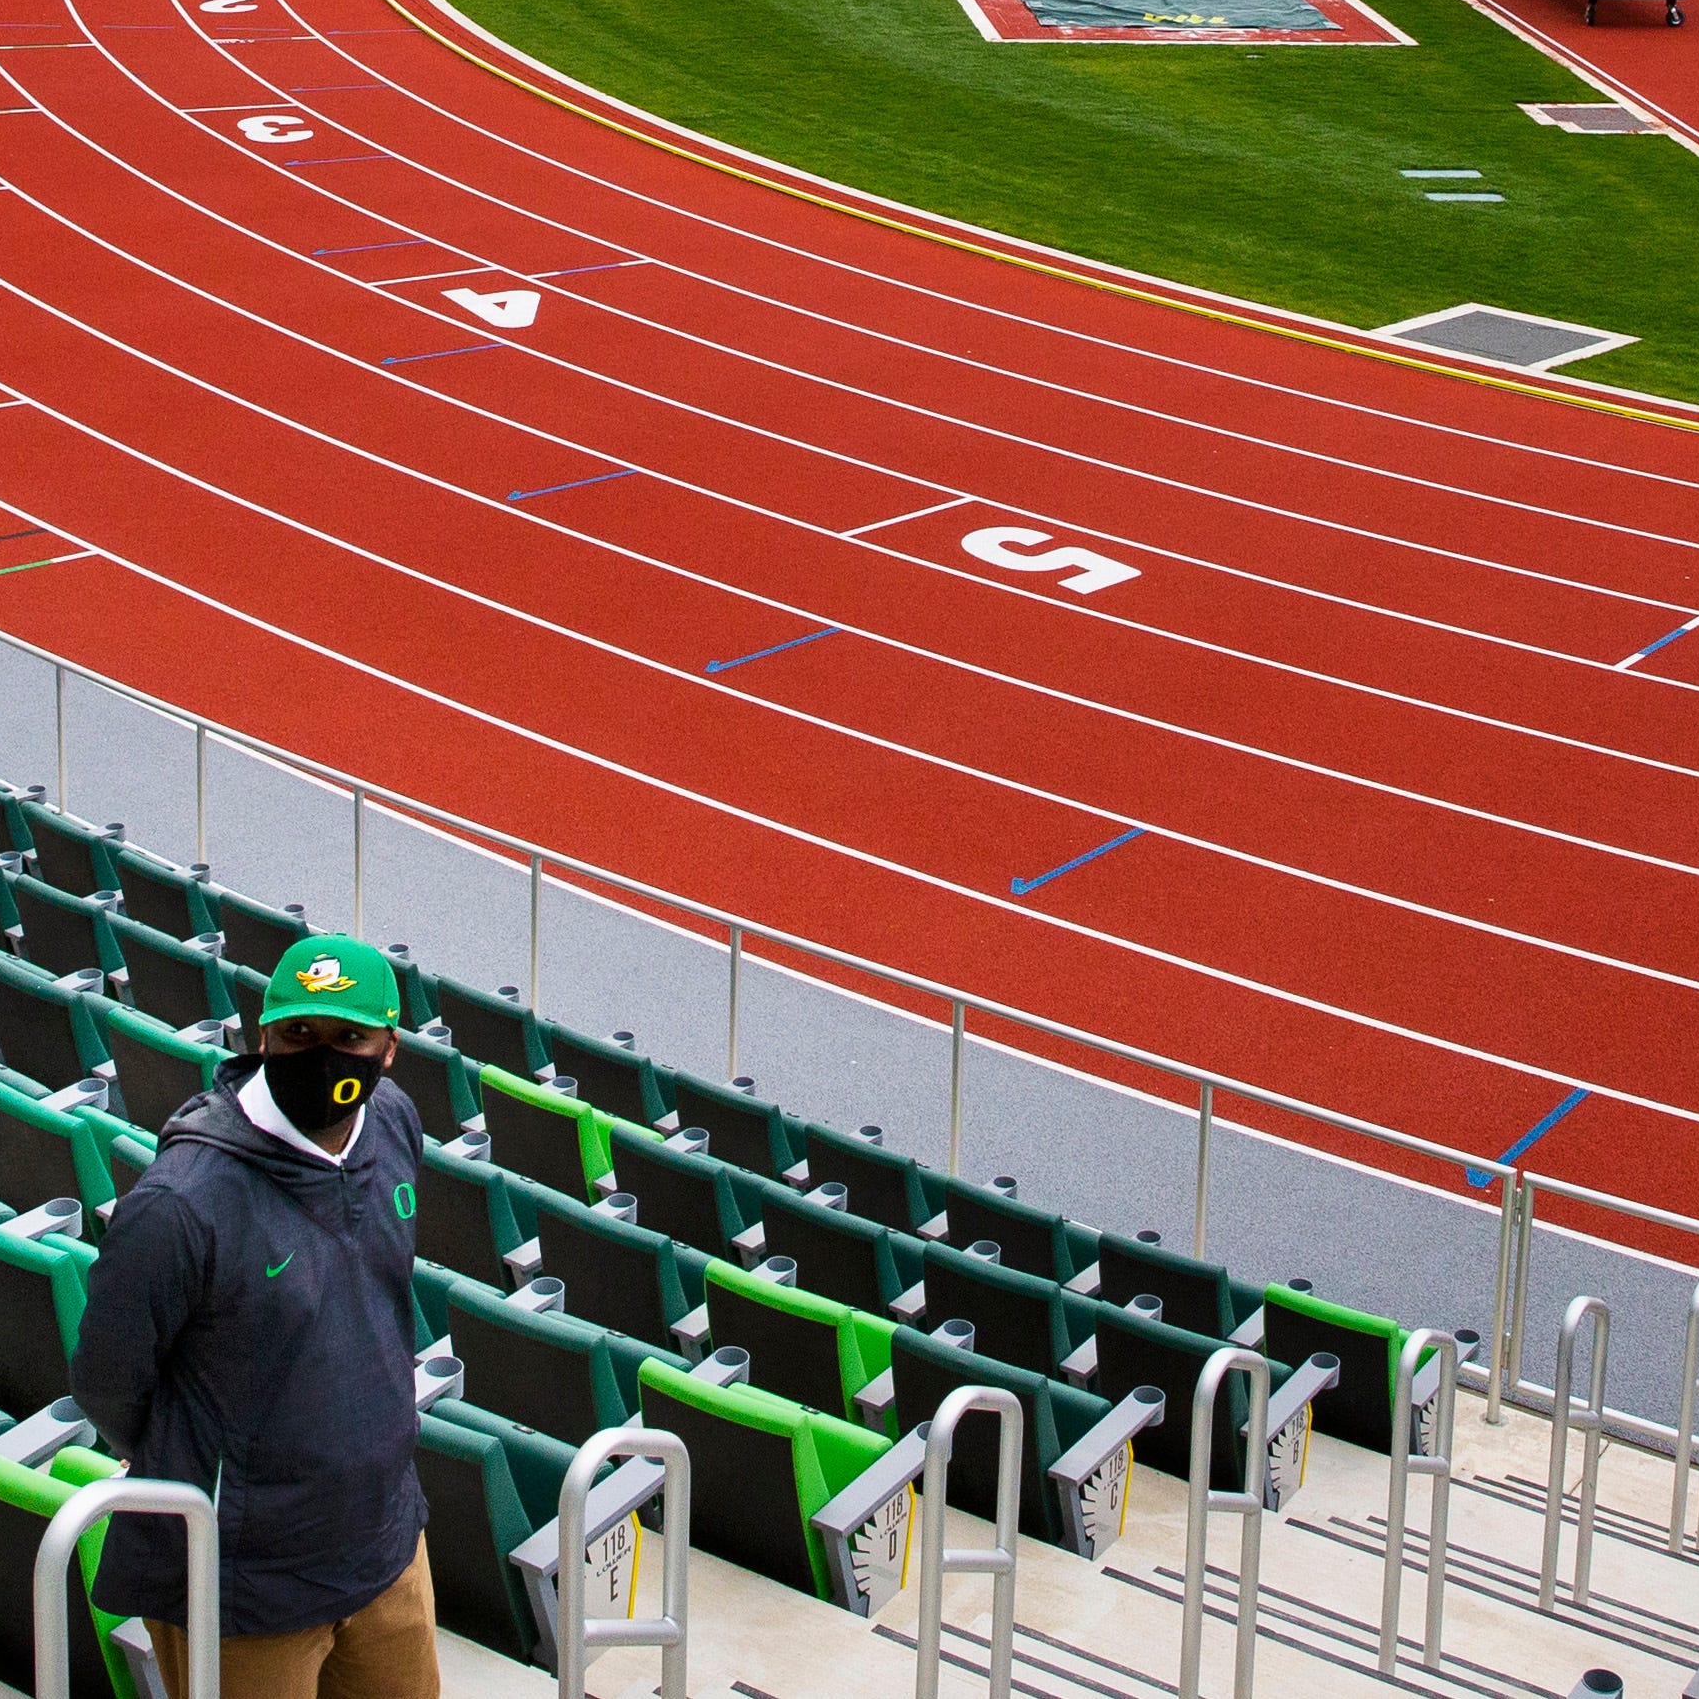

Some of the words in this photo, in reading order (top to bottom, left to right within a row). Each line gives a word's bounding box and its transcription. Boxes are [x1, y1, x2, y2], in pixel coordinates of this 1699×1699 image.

[236, 115, 314, 143] 3
[440, 287, 542, 329] 4
[961, 526, 1142, 595] 5
[333, 1078, 361, 1104] O
[392, 1182, 417, 1220] O
[1108, 1449, 1124, 1479] 118
[885, 1492, 904, 1526] 118
[1110, 1482, 1118, 1511] C
[602, 1524, 626, 1563] 118
[888, 1529, 897, 1562] D
[609, 1565, 619, 1602] E
